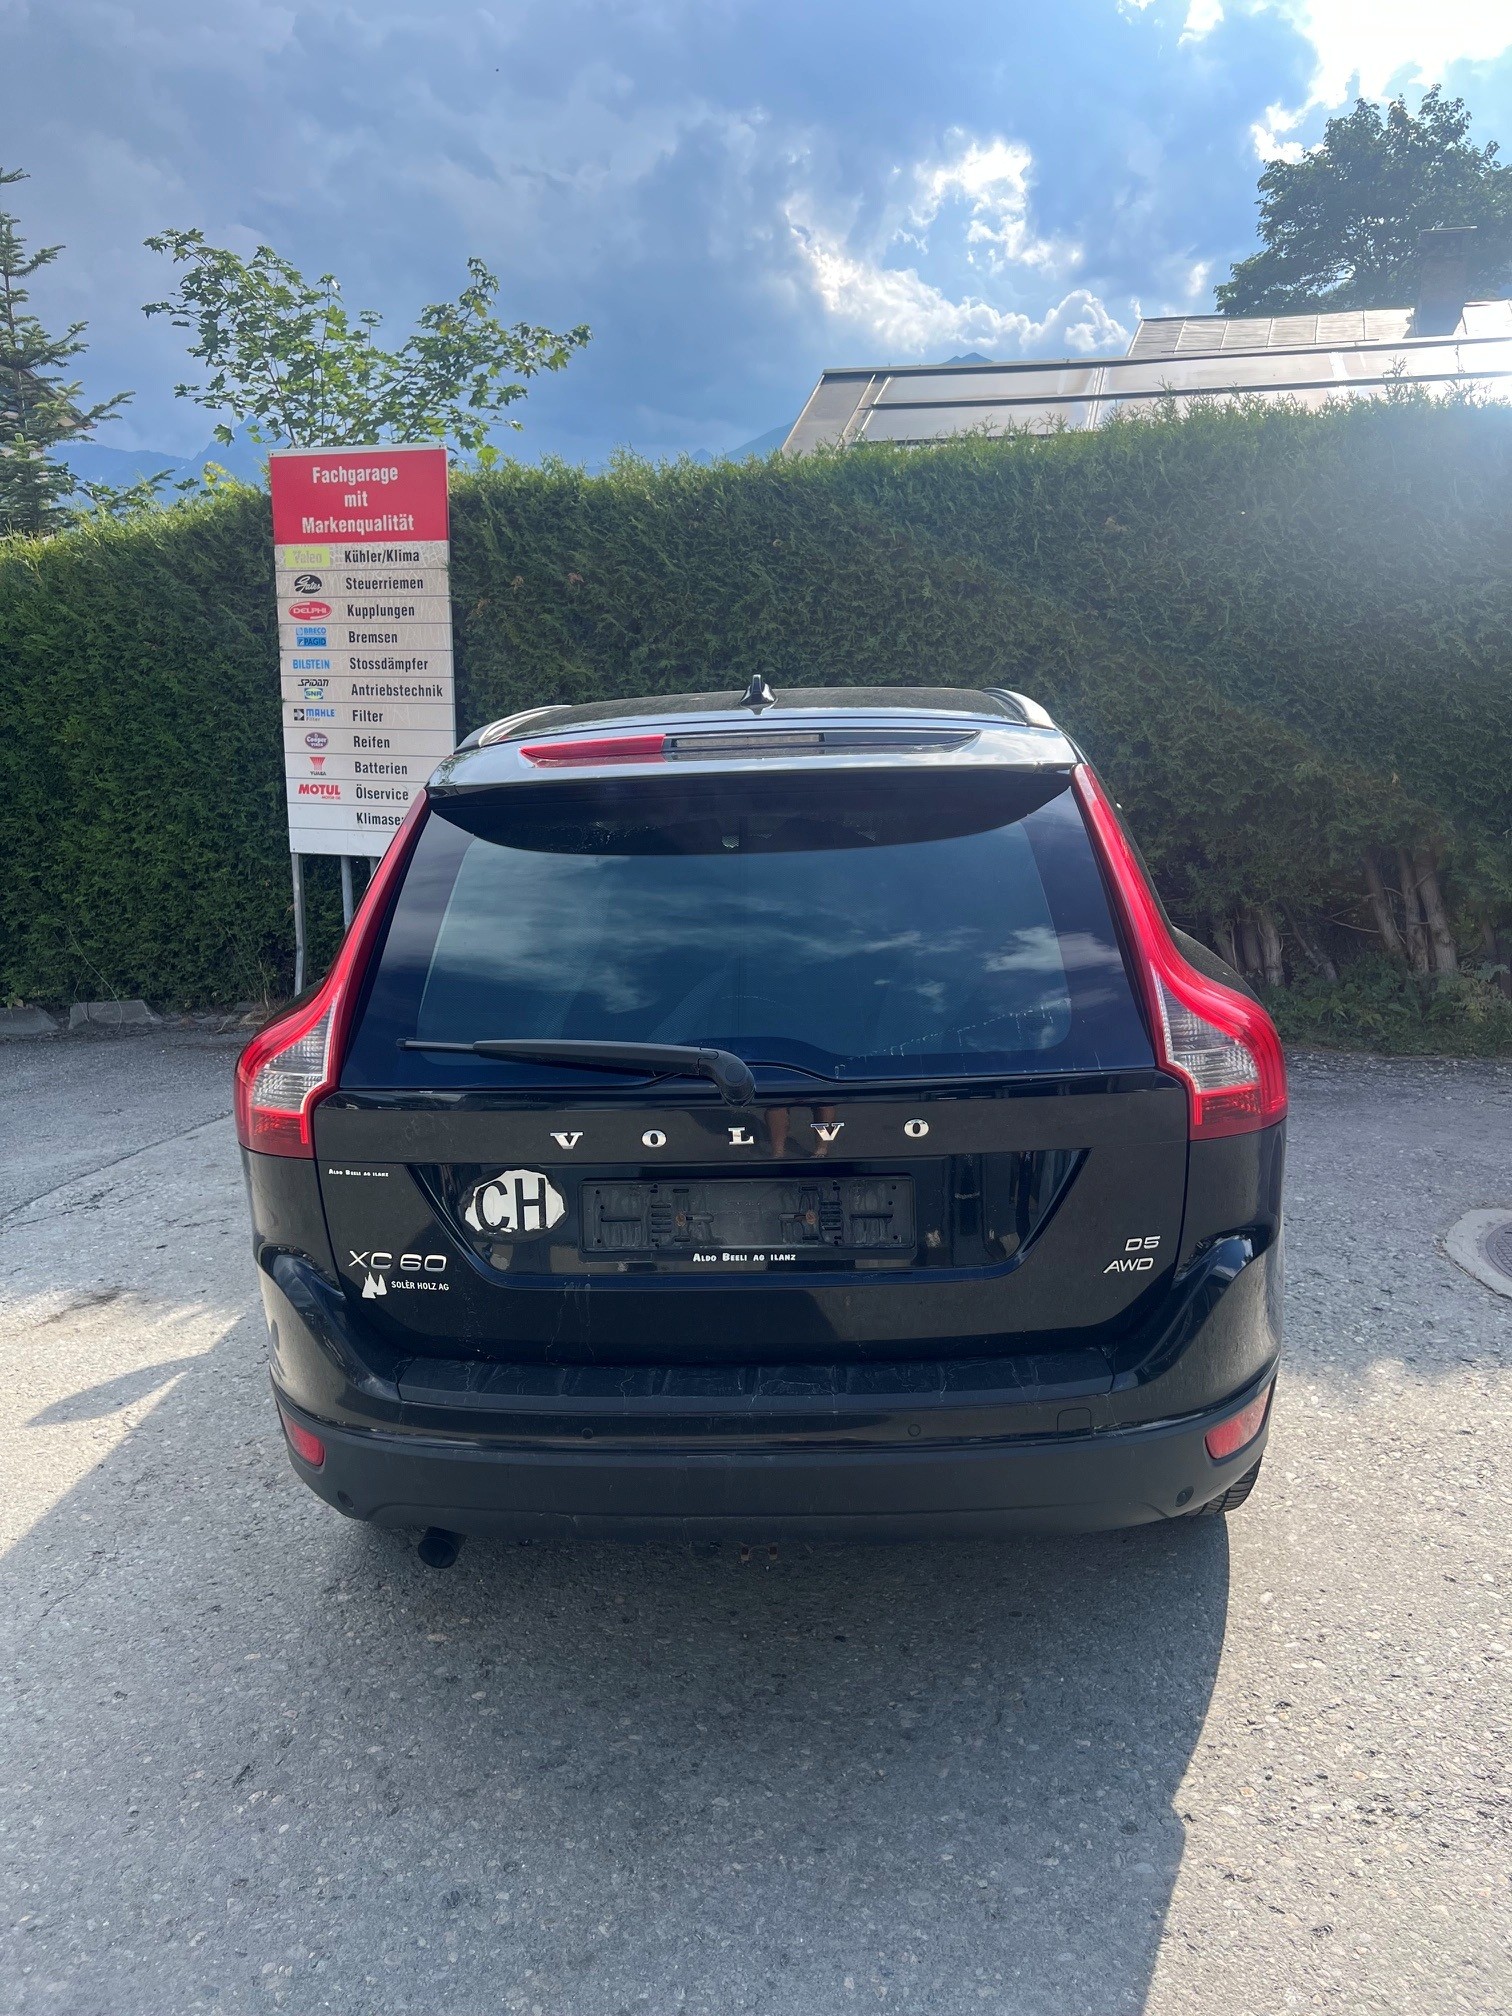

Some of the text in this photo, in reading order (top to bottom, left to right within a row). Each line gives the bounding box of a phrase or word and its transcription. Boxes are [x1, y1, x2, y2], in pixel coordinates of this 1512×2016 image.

[312, 466, 398, 486] Fachgarage
[344, 490, 368, 507] mit
[302, 513, 414, 535] Markenqualität
[344, 549, 420, 563] Kühler/Klima
[345, 577, 424, 590] Steuerriemen
[347, 604, 415, 619] Kupplungen
[348, 631, 398, 643] Bremsen
[292, 659, 330, 669] BILSTEIN
[349, 657, 428, 672] Stossdämpfer
[351, 684, 443, 697] Antriebstechnik
[306, 708, 335, 718] MAHLE
[352, 710, 383, 722] Filter
[353, 735, 390, 748] Reifen
[355, 761, 408, 775] Batterien
[298, 783, 340, 796] MOTUL
[356, 784, 409, 800] Ölservice
[550, 1117, 930, 1150] VOLVO
[474, 1177, 547, 1233] CH
[1125, 1235, 1161, 1251] D5
[1102, 1257, 1154, 1274] AWD
[438, 1283, 449, 1291] AG
